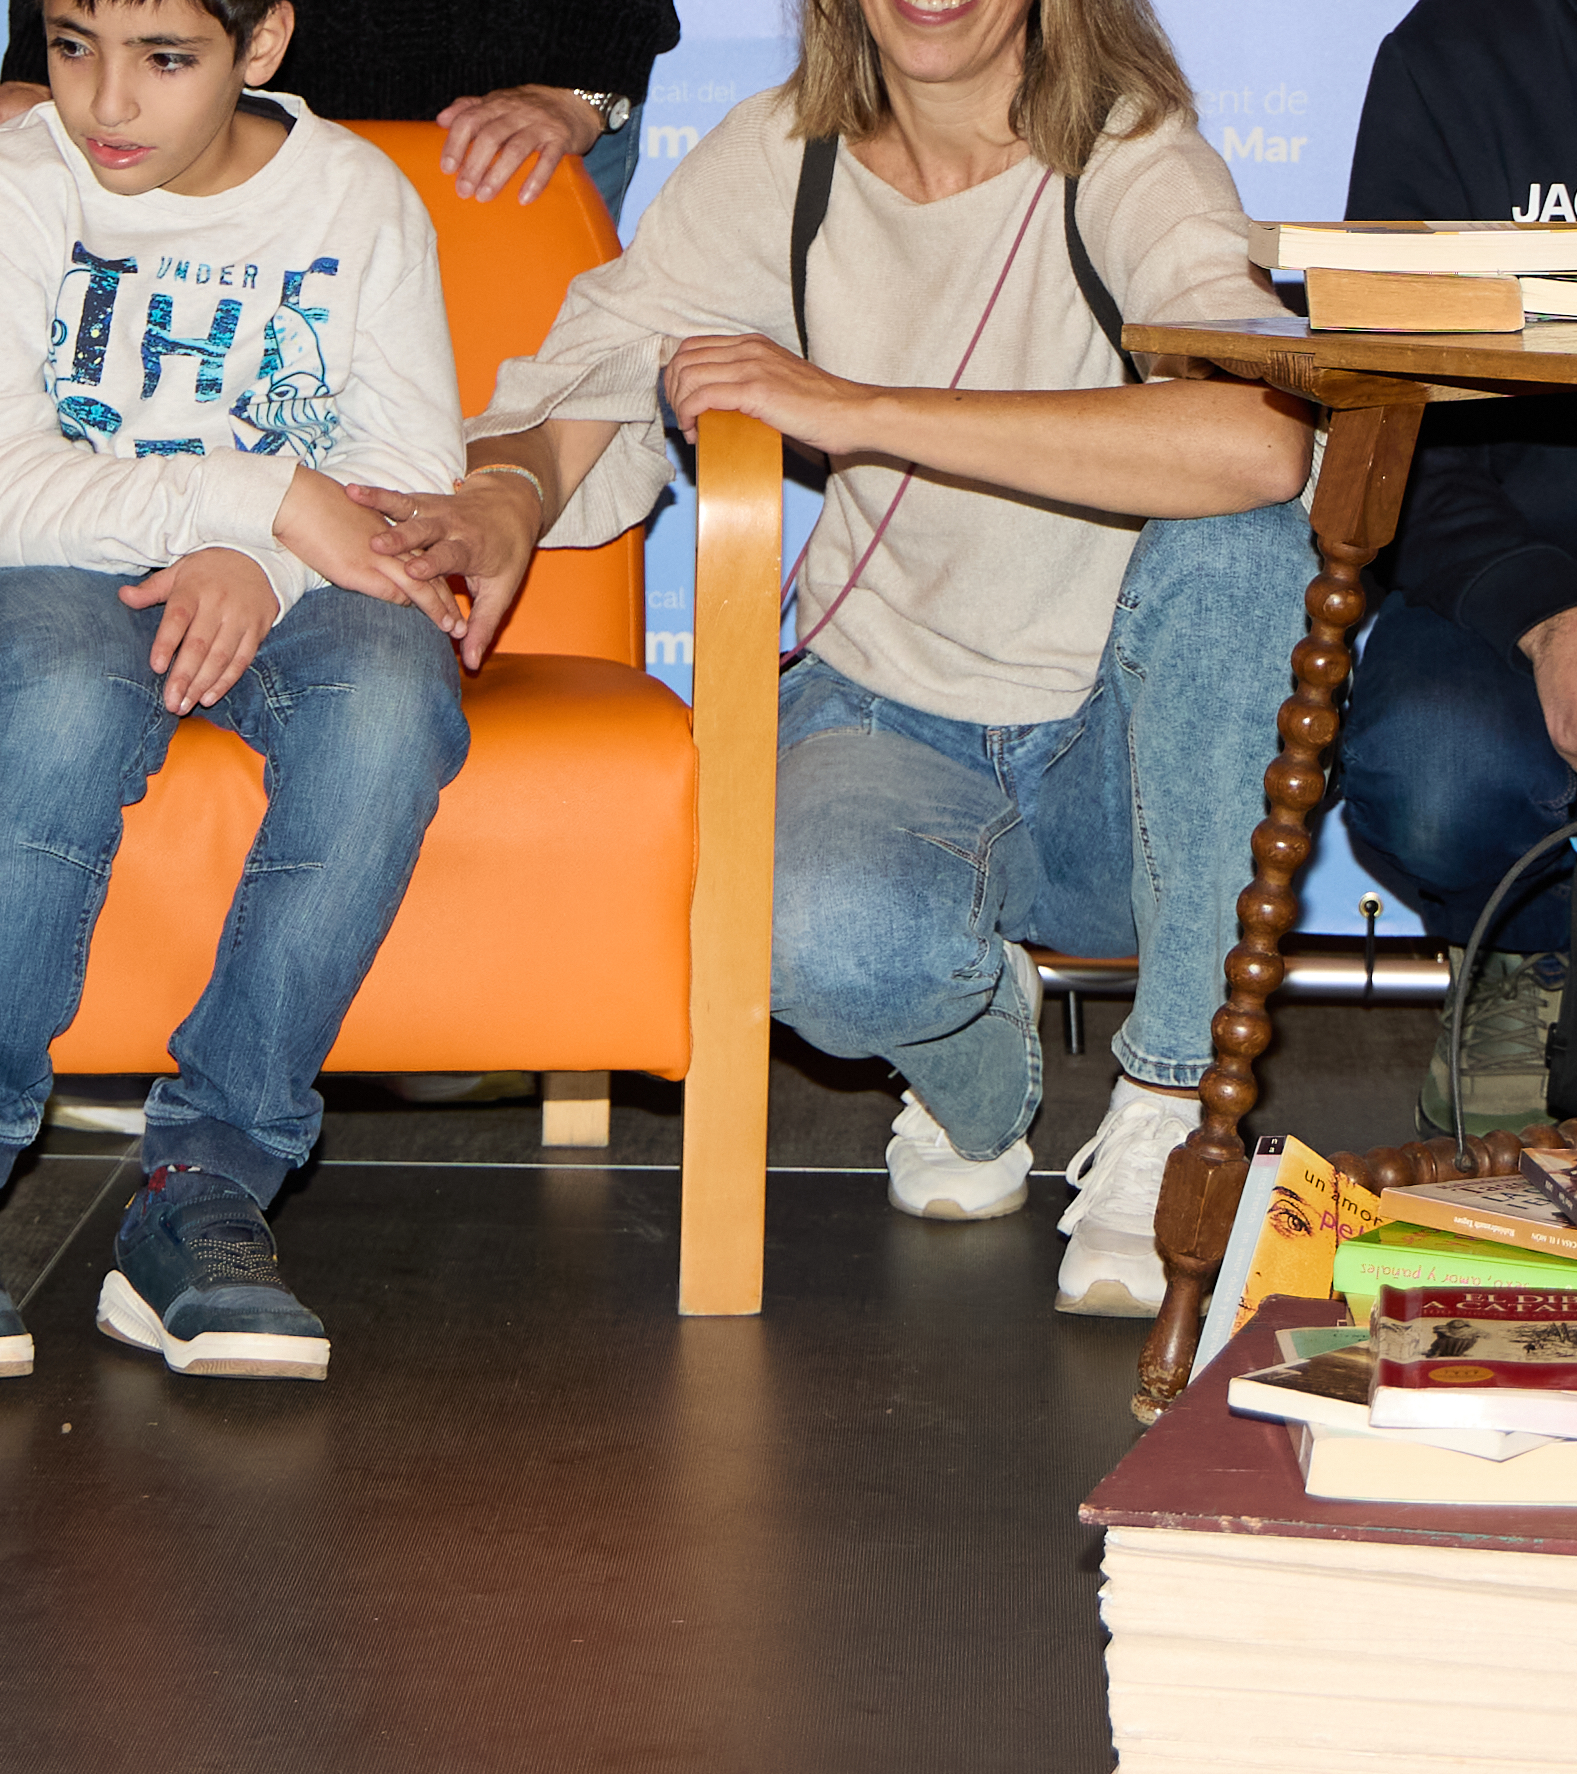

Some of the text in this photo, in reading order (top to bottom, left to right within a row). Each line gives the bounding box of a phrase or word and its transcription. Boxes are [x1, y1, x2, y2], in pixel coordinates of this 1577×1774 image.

[156, 255, 259, 290] UNDER
[1304, 1168, 1326, 1192] un
[1359, 1263, 1422, 1281] pañales
[1442, 1272, 1481, 1288] amor
[1422, 1301, 1444, 1310] A
[1464, 1294, 1506, 1303] EL
